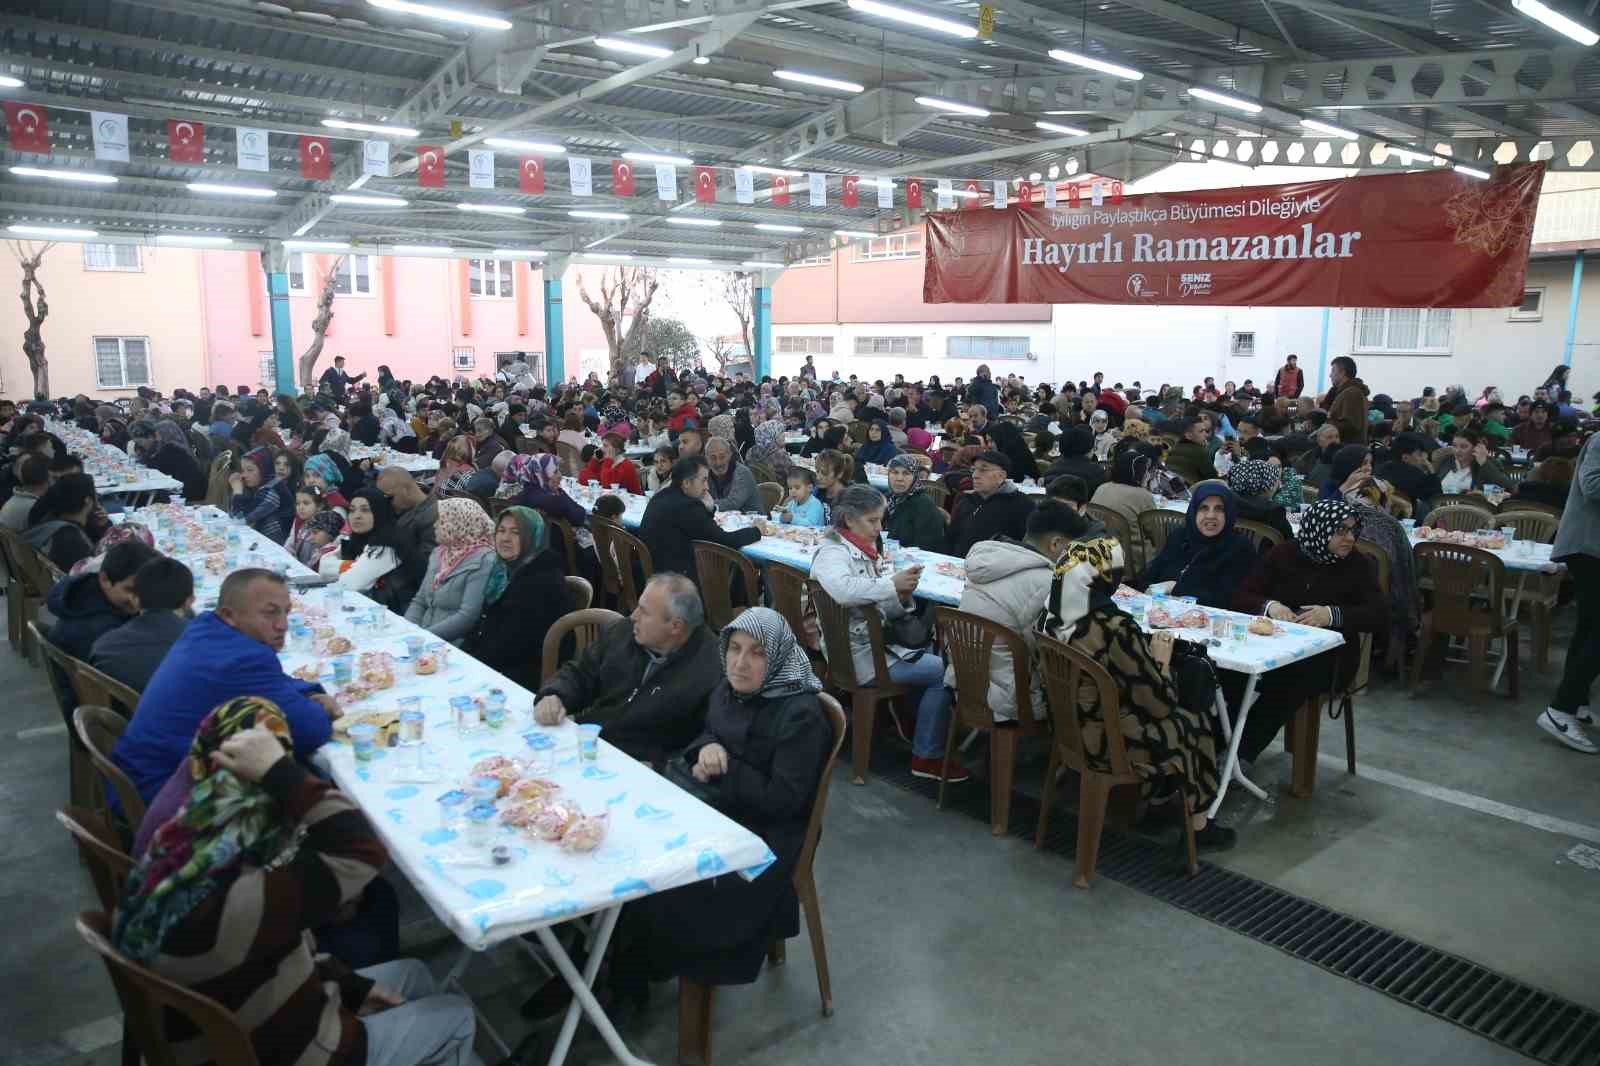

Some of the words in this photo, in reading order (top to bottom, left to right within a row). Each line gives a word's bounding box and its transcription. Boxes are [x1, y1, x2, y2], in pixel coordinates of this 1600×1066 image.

[1170, 200, 1246, 223] Büyümesi
[1250, 195, 1321, 219] Dileğiyle
[1021, 232, 1123, 273] Hayırlı
[1132, 222, 1362, 263] Ramazanlar
